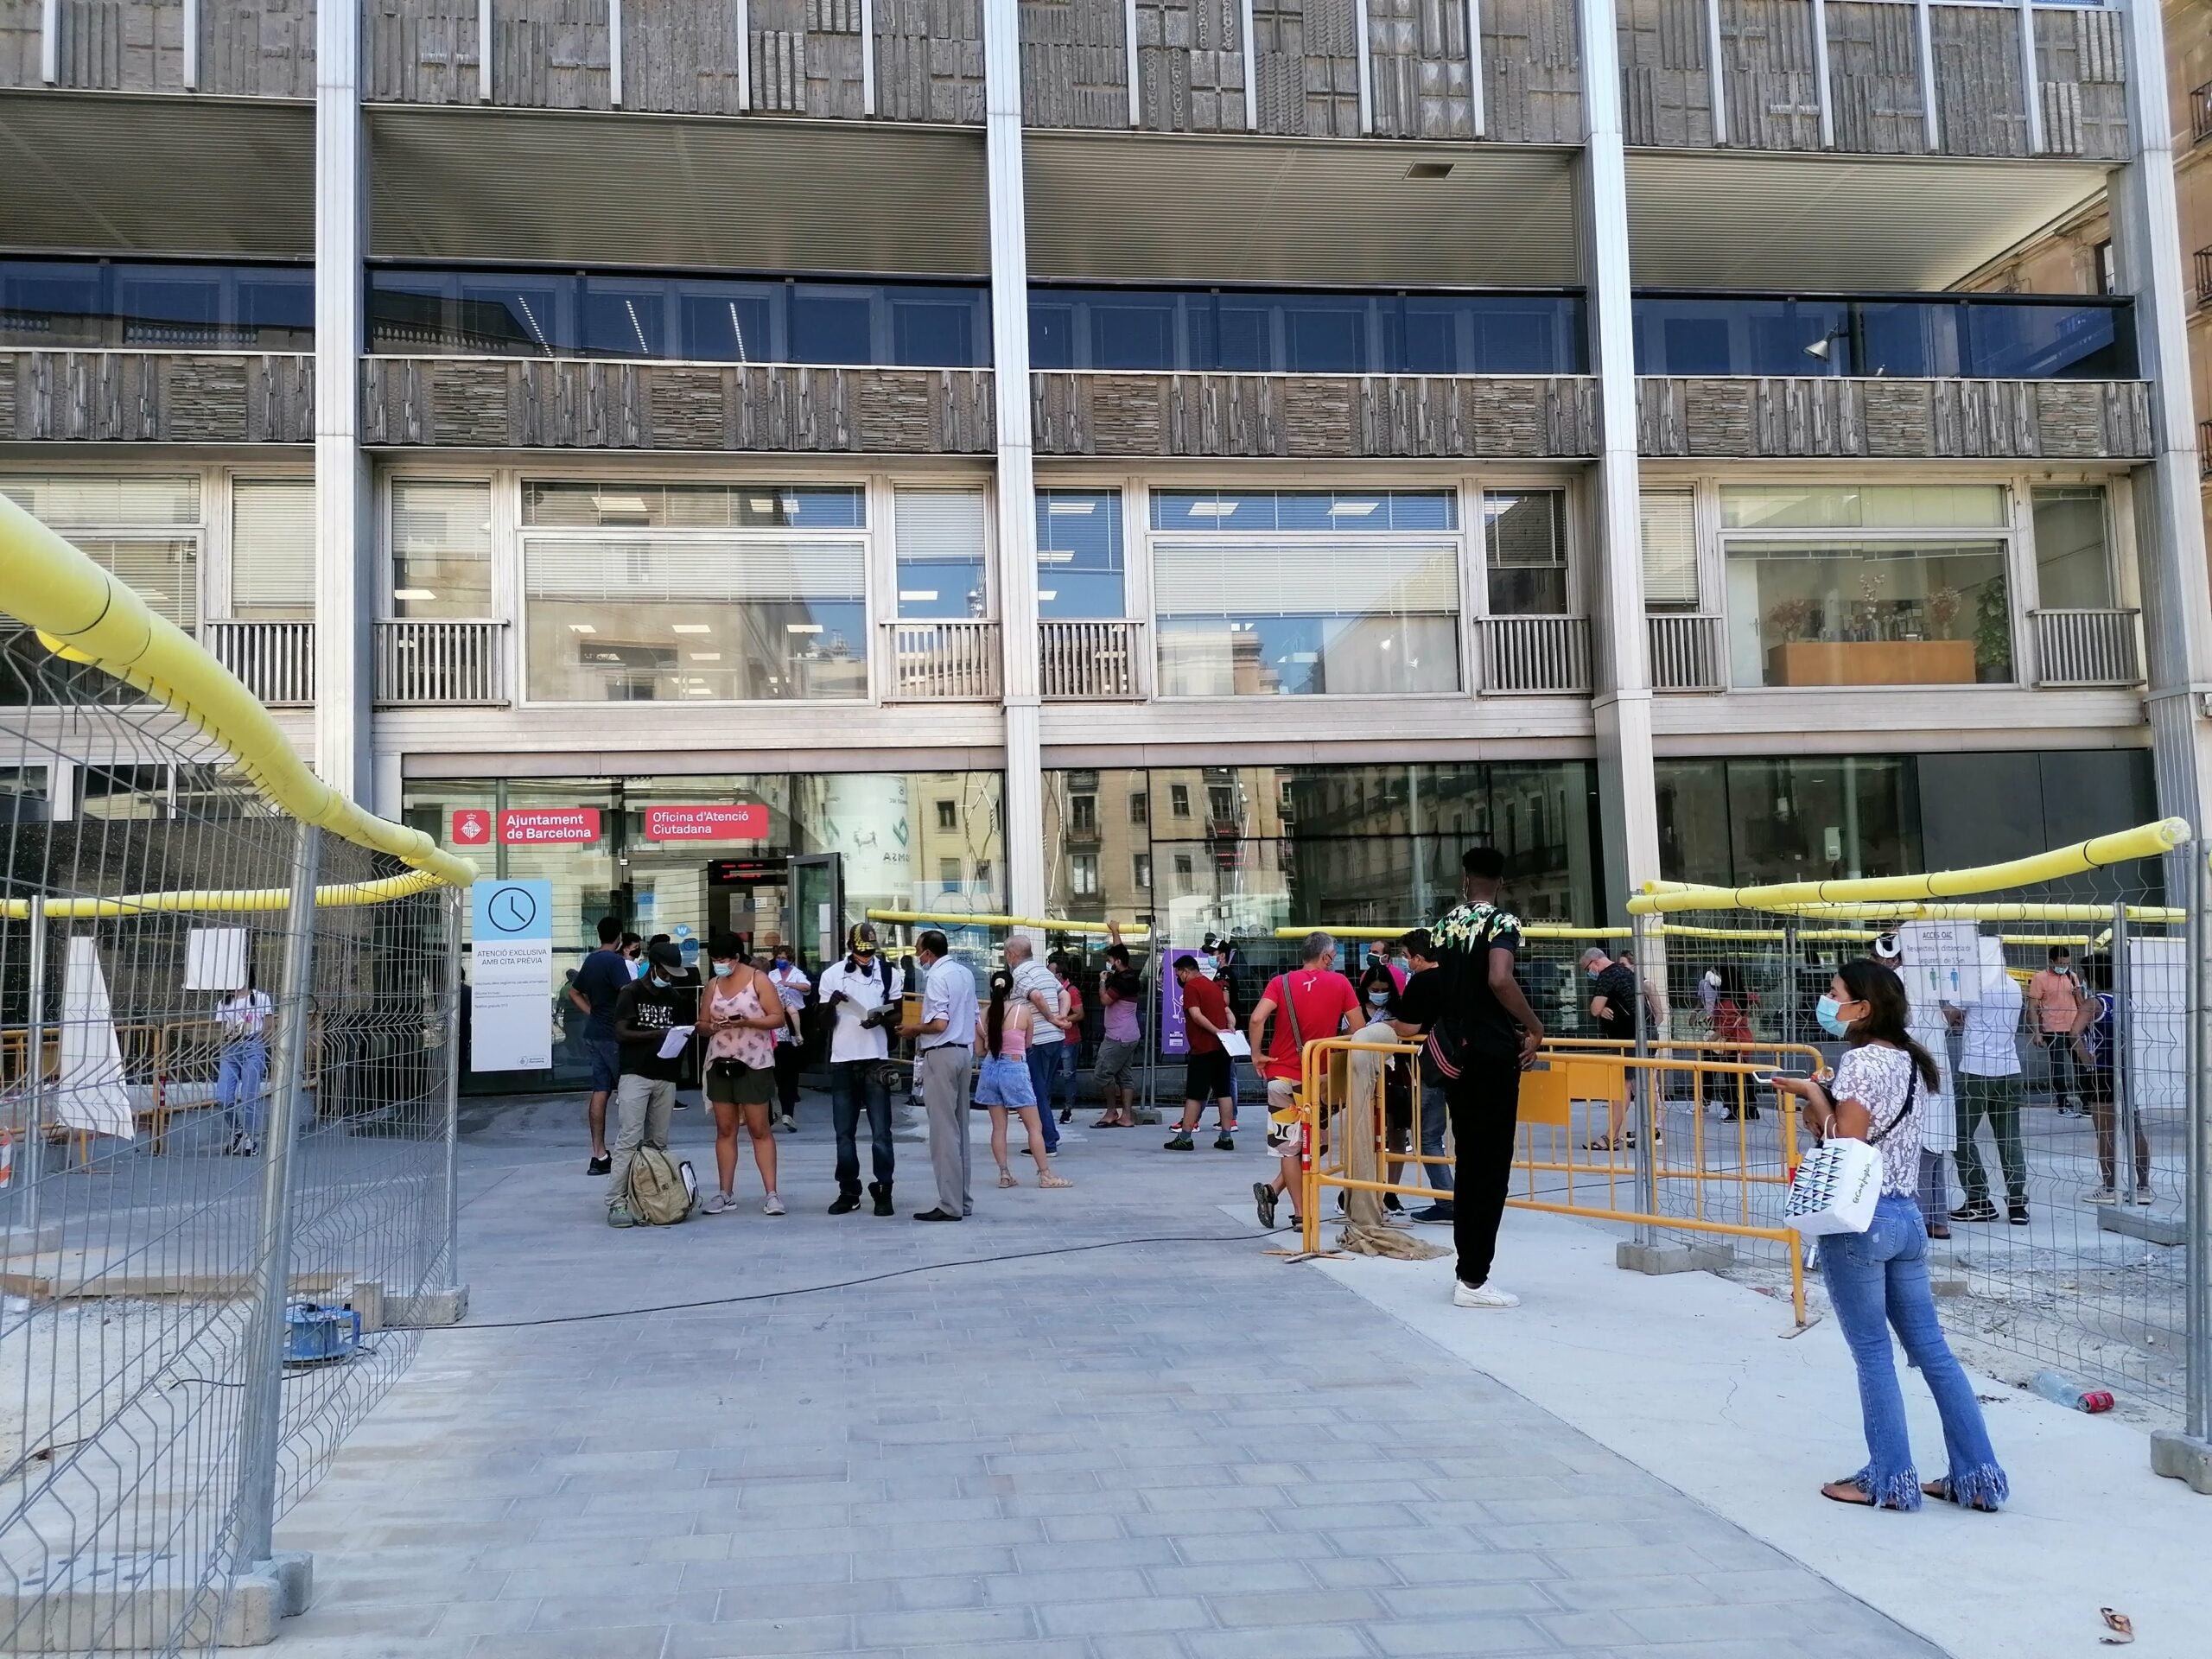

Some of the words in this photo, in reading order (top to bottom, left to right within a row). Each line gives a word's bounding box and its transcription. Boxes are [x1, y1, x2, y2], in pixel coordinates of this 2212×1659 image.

[506, 814, 584, 828] Ajuntament
[652, 812, 694, 823] Oficina
[696, 811, 749, 822] d'Atenció
[506, 829, 524, 840] de
[526, 828, 592, 839] Barcelona
[652, 824, 712, 835] Ciutadana
[477, 949, 508, 957] ATENCIÓ
